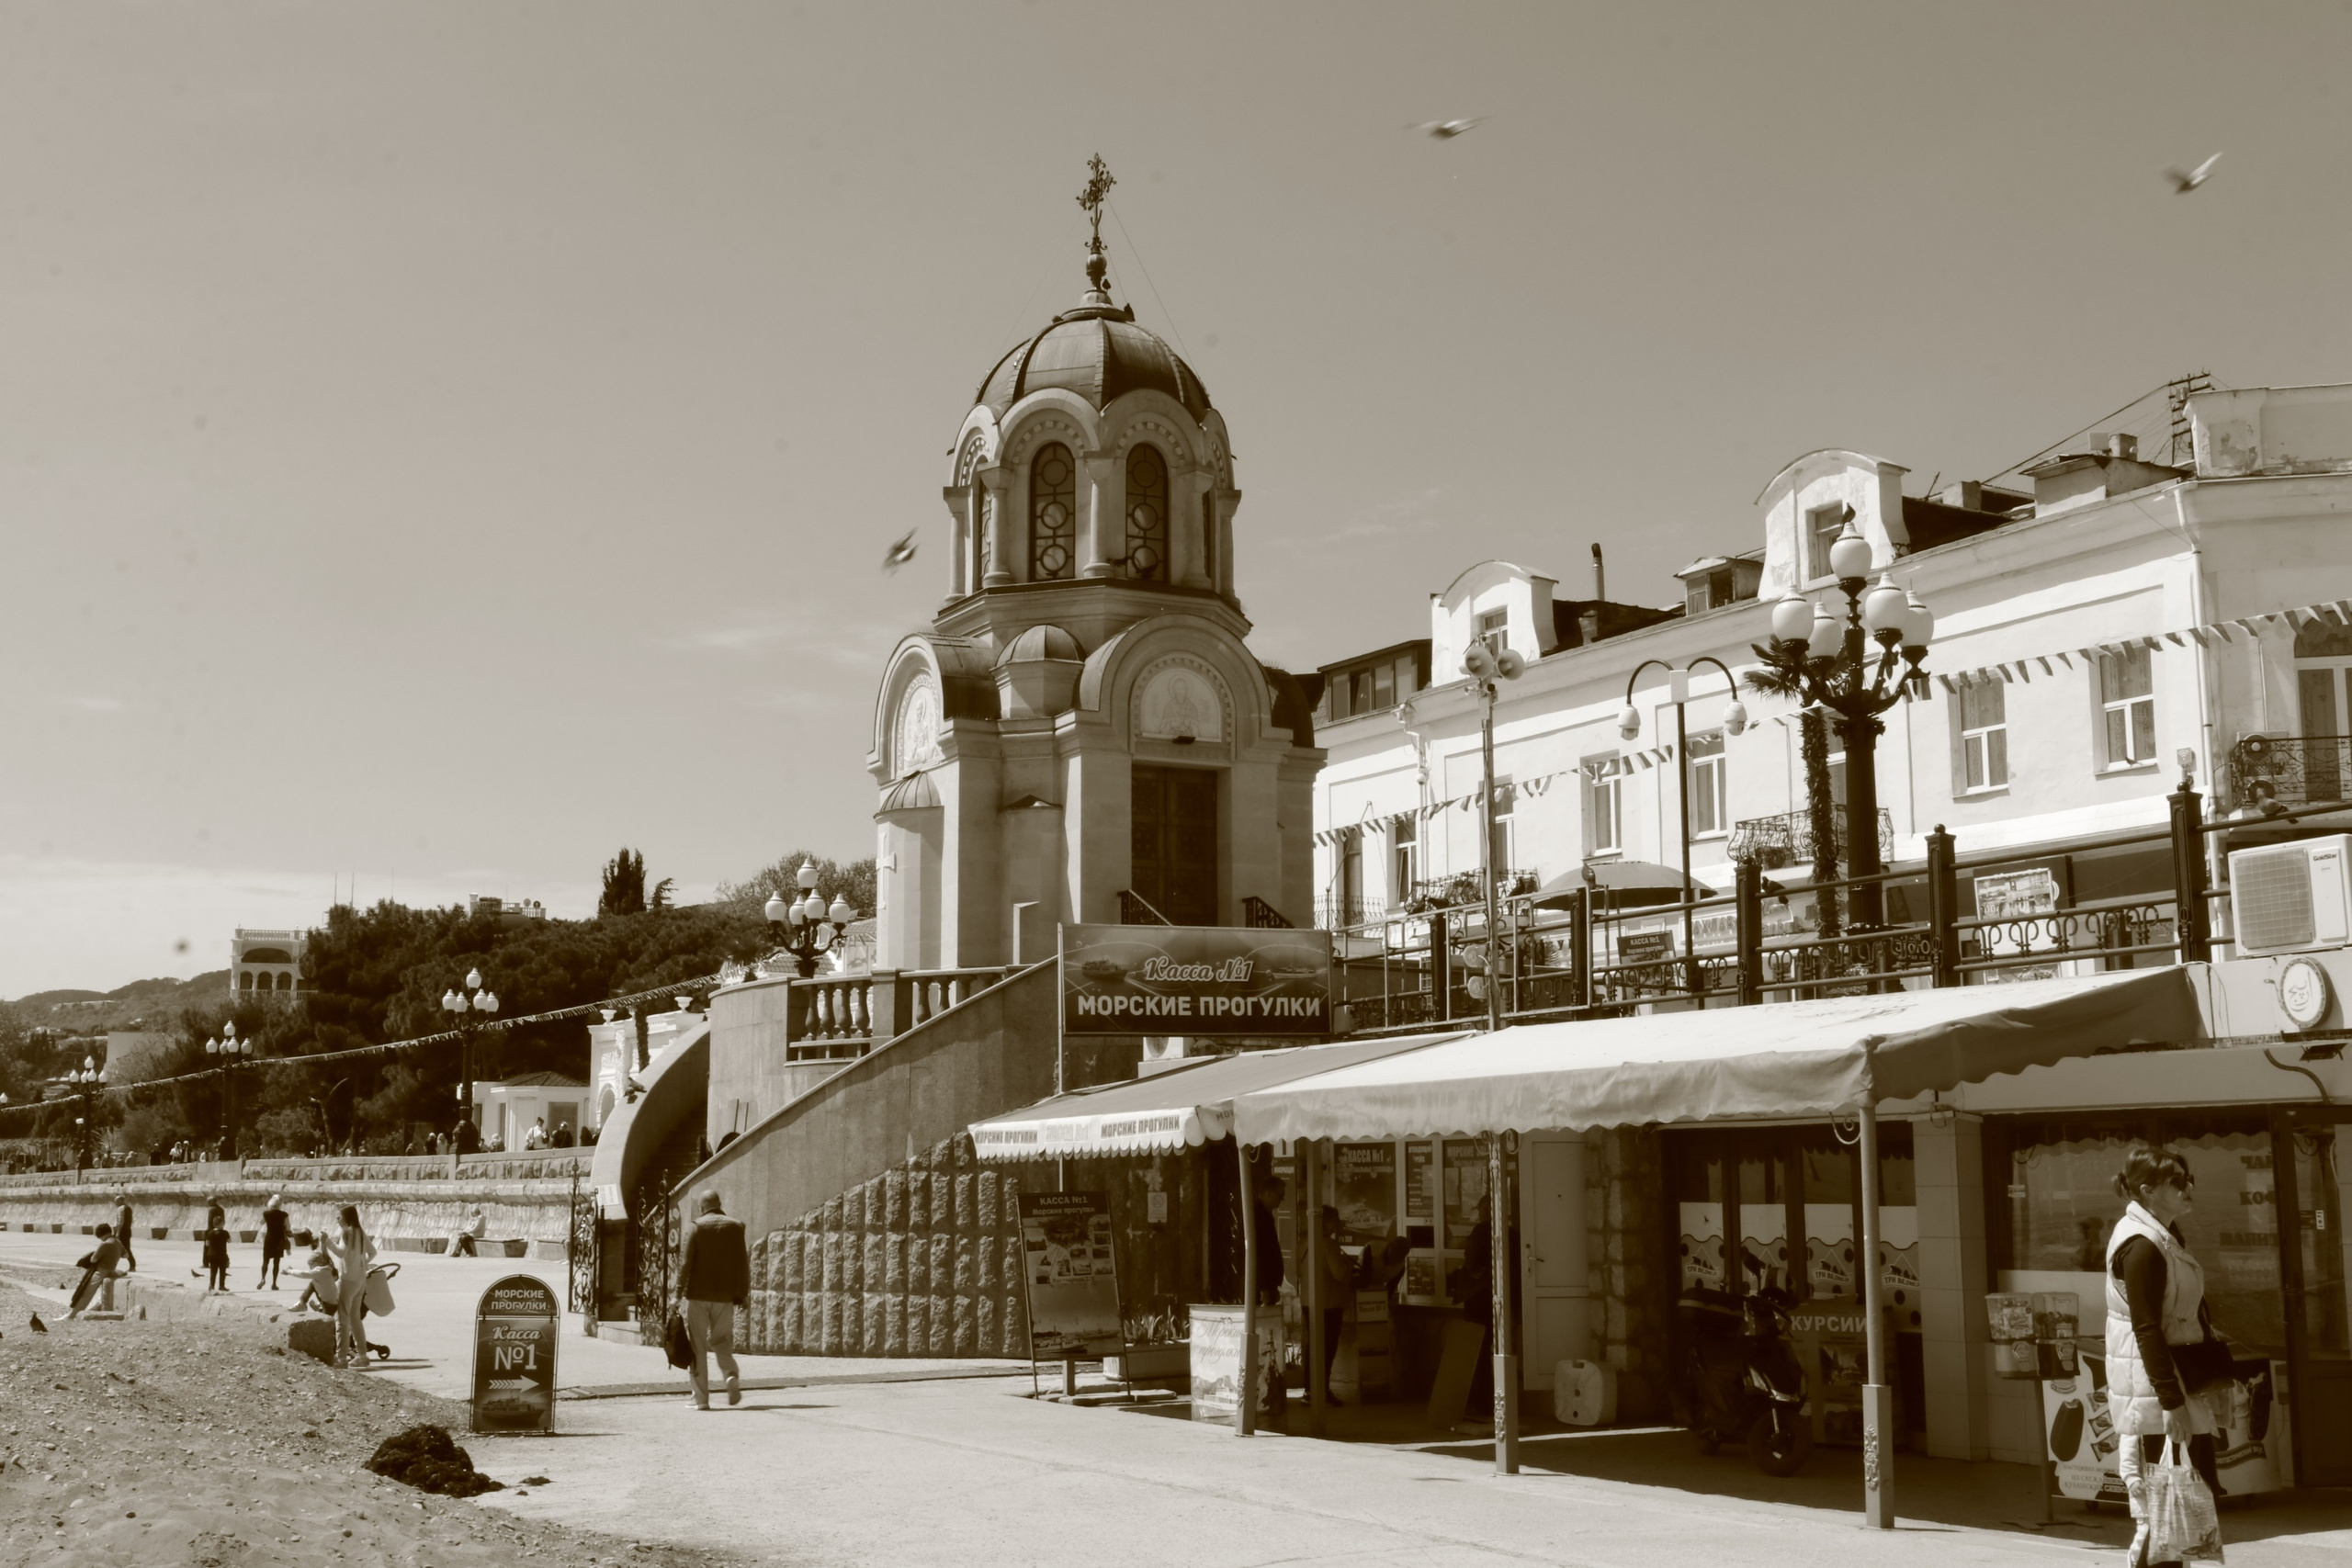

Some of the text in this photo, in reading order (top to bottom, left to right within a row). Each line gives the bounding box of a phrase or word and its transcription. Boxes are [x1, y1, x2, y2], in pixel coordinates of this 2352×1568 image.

[1630, 937, 1649, 945] КАССА
[1145, 956, 1254, 982] Касса №1
[1078, 995, 1320, 1017] МОРСКИЕ ПРОГУЛКИ
[1101, 1115, 1180, 1138] МОРСКИЕ ПРОГУЛКИ
[975, 1130, 1037, 1144] МОРСКИЕ ПРОГУЛКИ
[1348, 1148, 1384, 1163] КАССА №1
[1039, 1197, 1070, 1205] КАССА
[1815, 1271, 1826, 1280] ТРИ
[1884, 1276, 1896, 1285] ТРИ
[494, 1289, 545, 1299] МОРСКИЕ
[491, 1301, 547, 1311] ПРОГУЛКИ
[492, 1325, 541, 1340] Касса
[494, 1344, 537, 1370] №1
